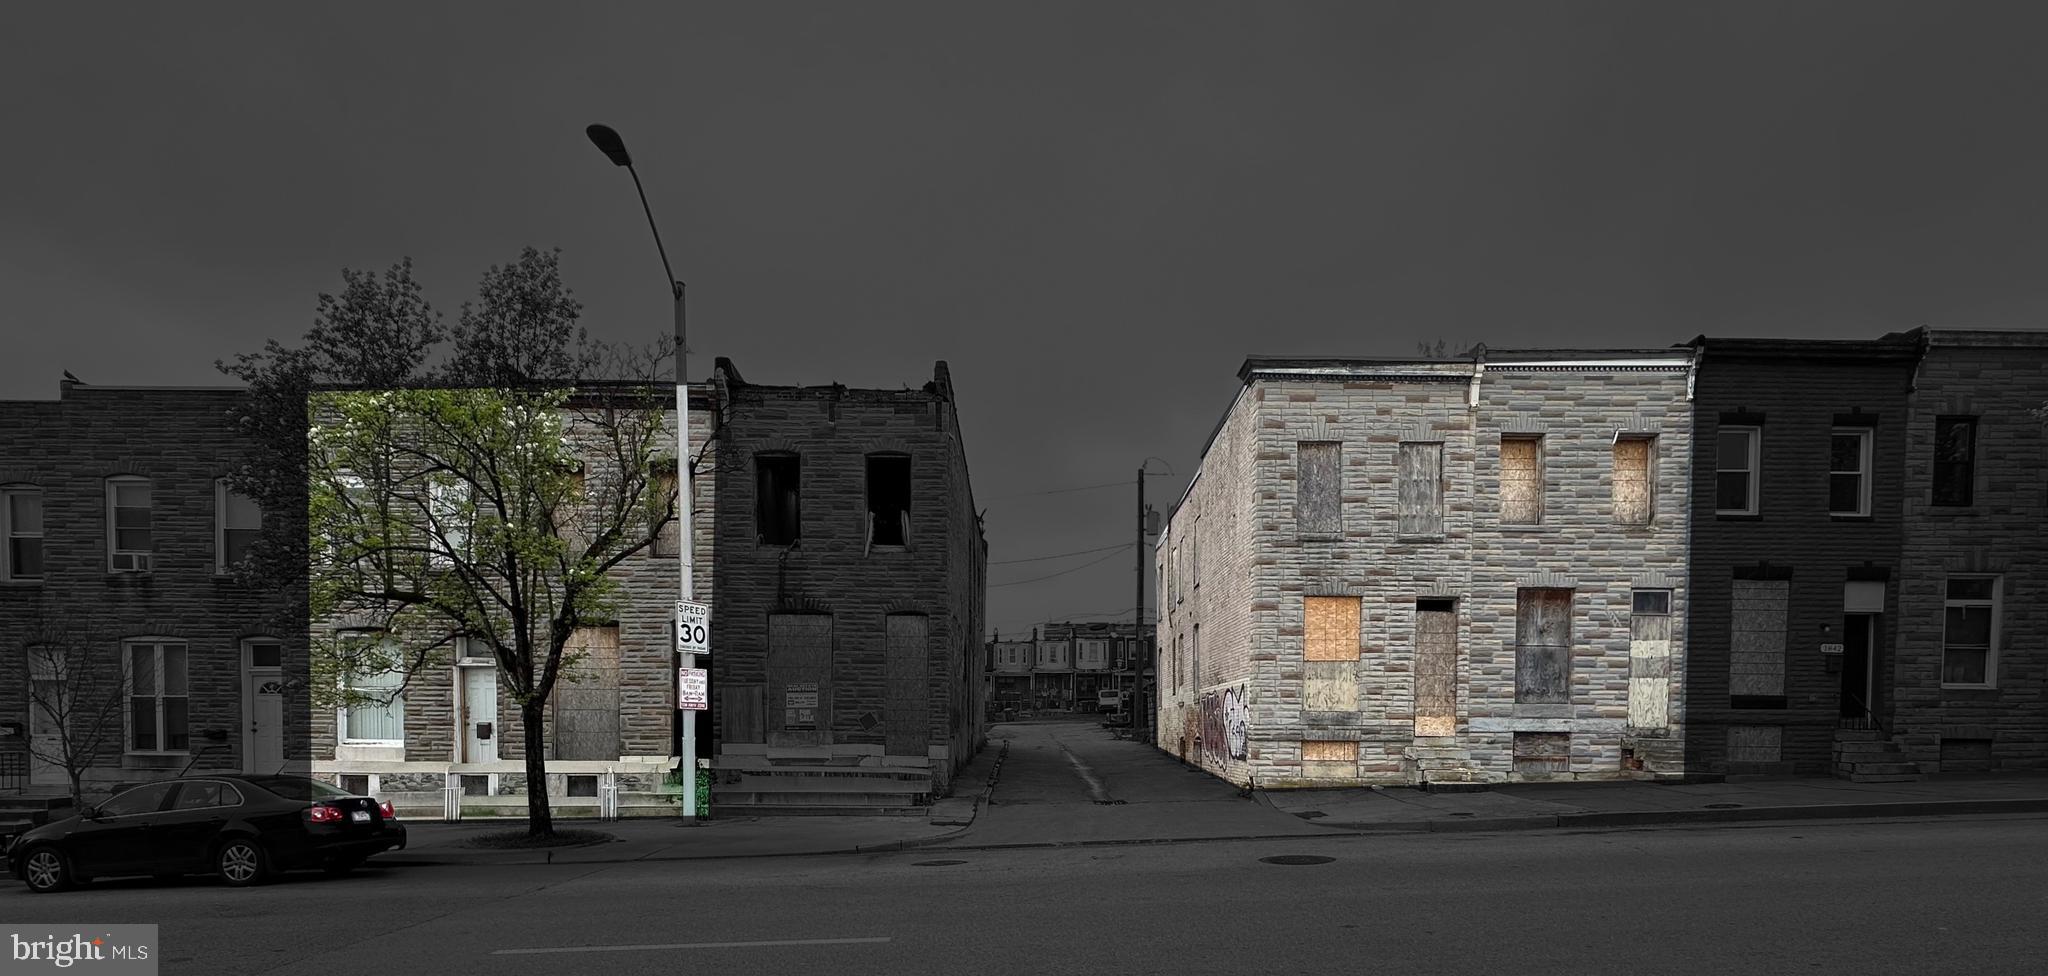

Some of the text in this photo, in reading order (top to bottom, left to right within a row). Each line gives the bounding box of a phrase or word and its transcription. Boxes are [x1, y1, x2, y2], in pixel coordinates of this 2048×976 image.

[679, 604, 706, 615] SPEED
[681, 615, 703, 624] LIMIT
[680, 624, 705, 644] 30
